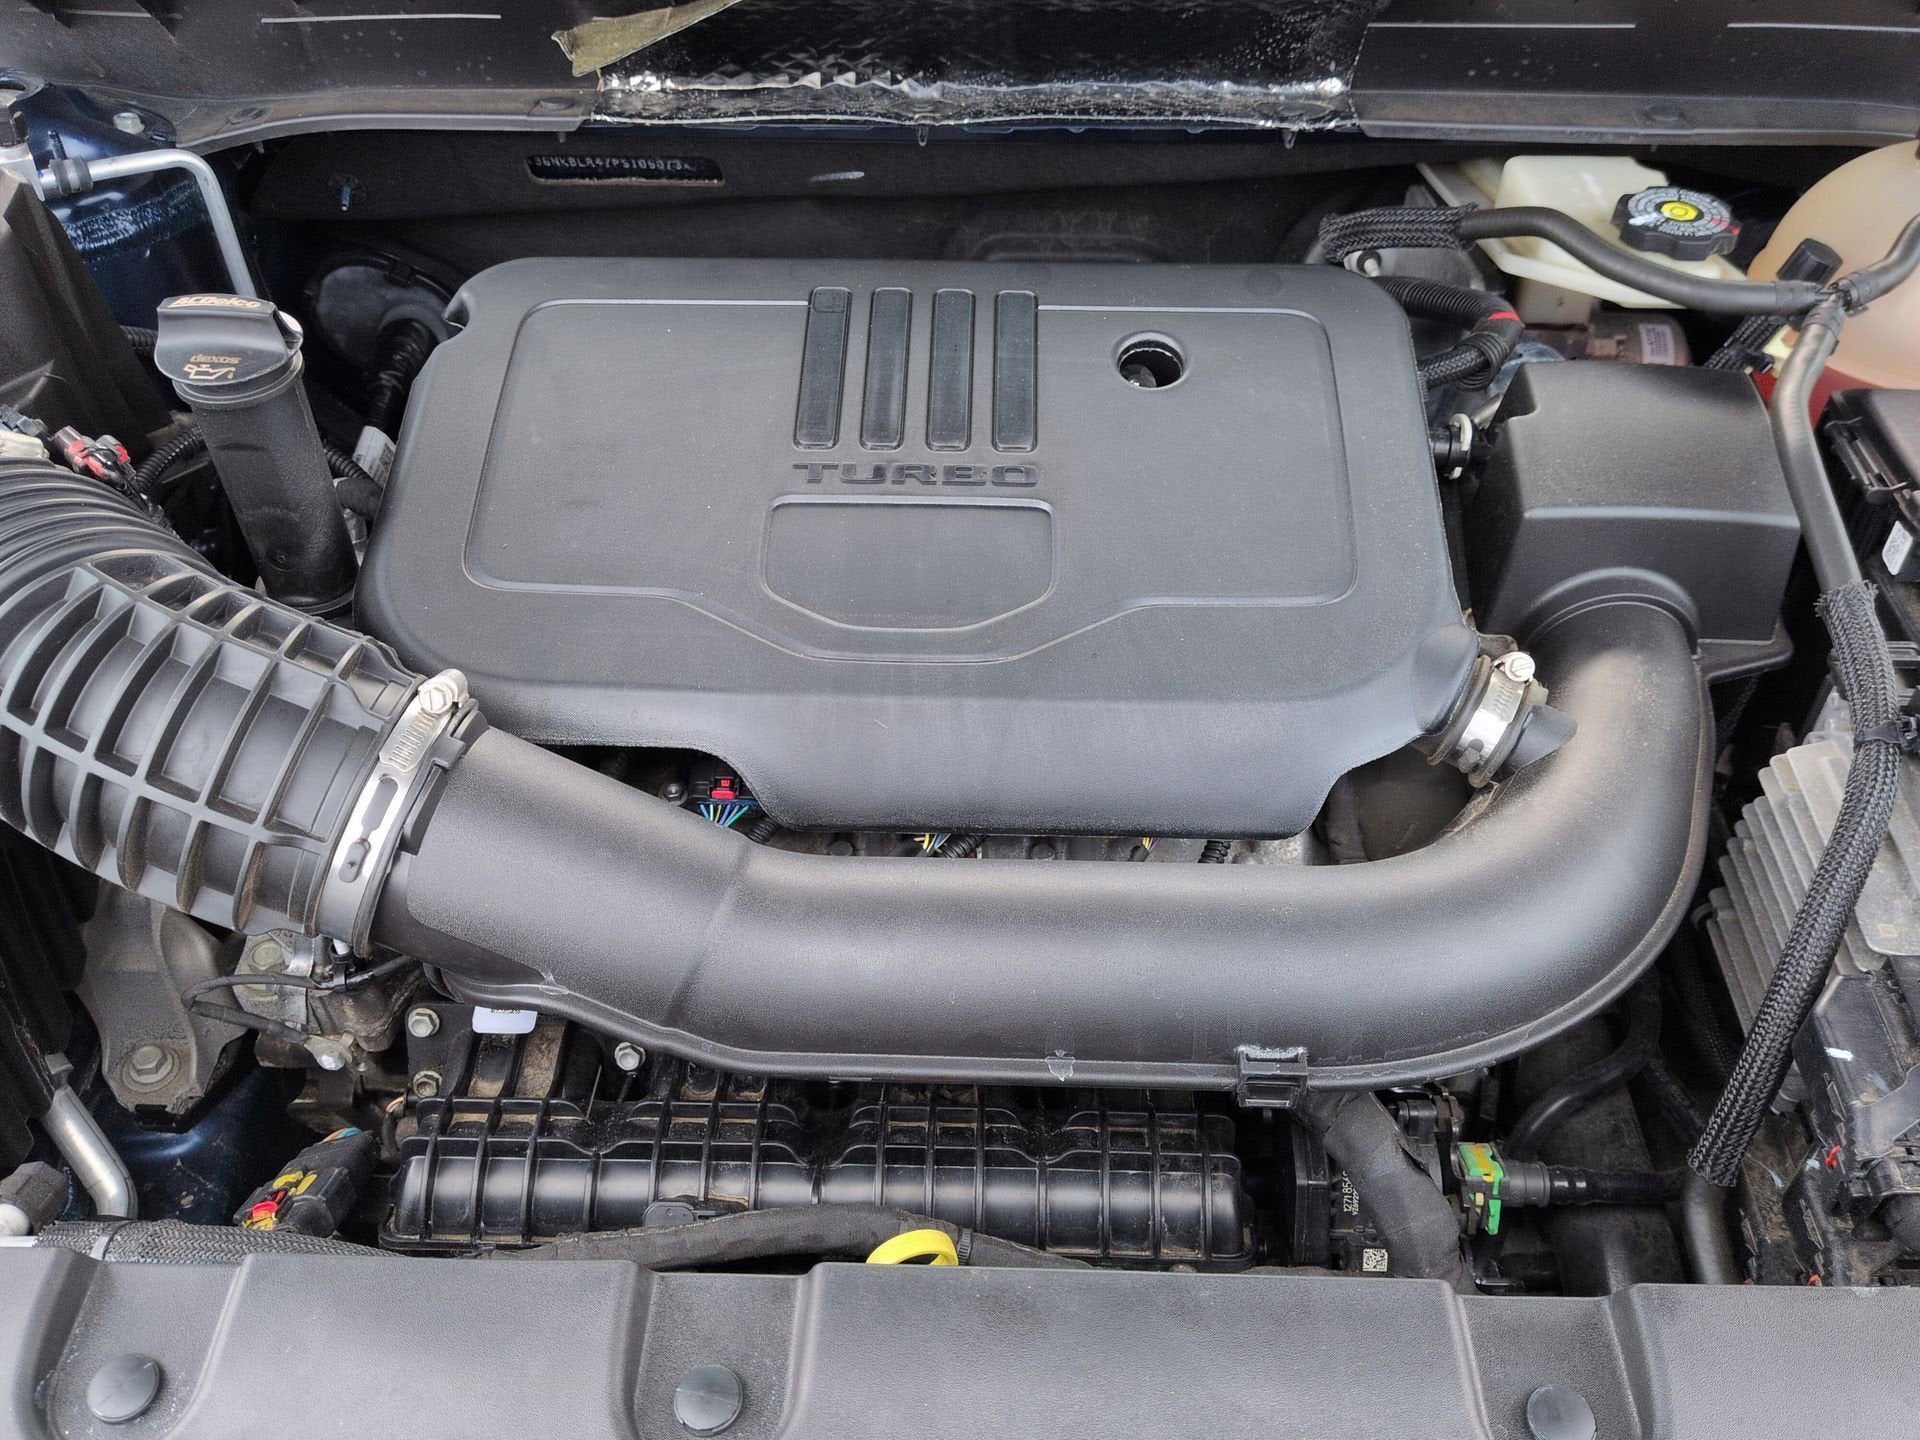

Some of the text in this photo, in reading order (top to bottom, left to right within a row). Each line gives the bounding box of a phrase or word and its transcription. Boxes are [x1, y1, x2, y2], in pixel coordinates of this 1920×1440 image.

[168, 296, 261, 308] ACDelco
[189, 353, 241, 364] dexos
[792, 463, 1038, 487] TURBO
